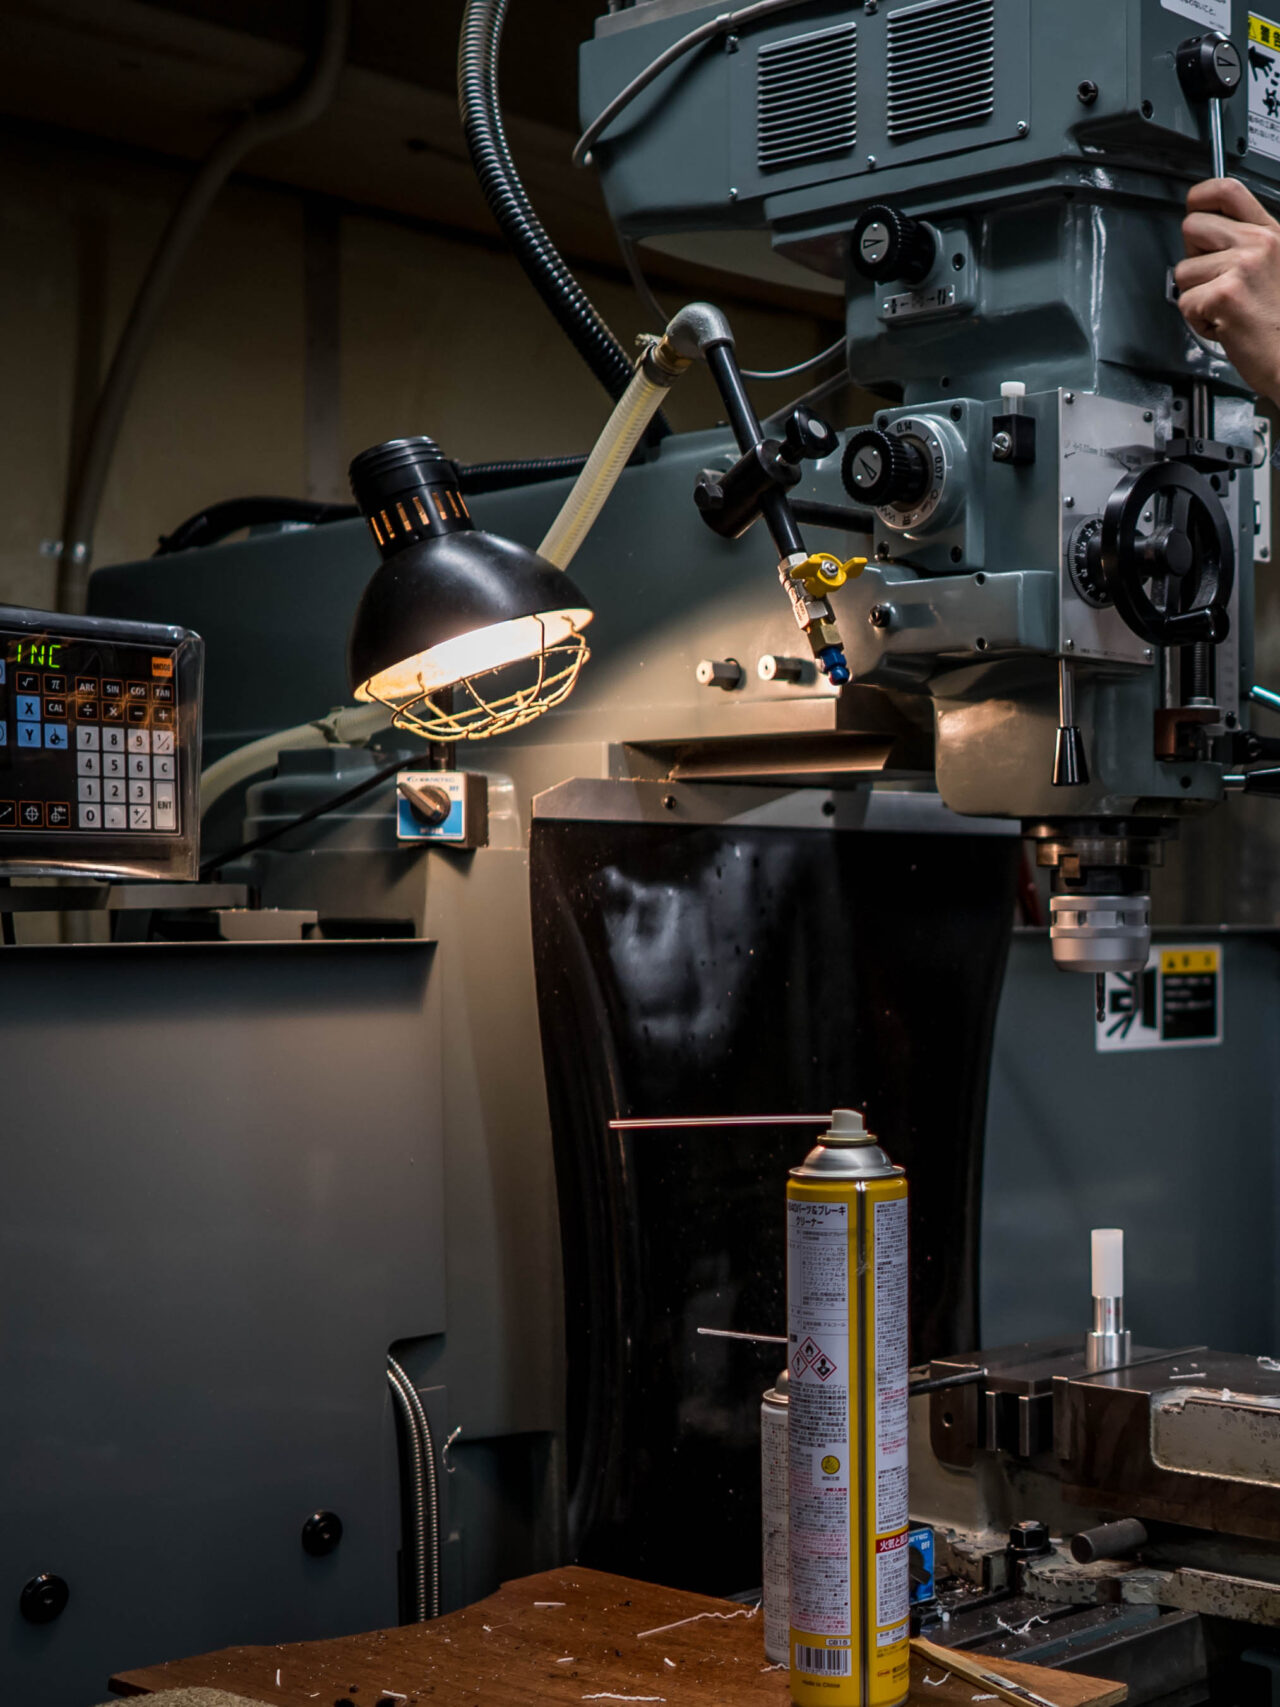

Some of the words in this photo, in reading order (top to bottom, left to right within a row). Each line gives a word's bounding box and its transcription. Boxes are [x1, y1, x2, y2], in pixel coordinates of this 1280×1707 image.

[935, 457, 943, 481] 0.07
[16, 644, 61, 669] INC
[79, 682, 95, 692] ARC
[106, 684, 120, 694] SIN
[130, 686, 146, 696] COS
[155, 688, 171, 699] TAN
[25, 702, 33, 715] X
[48, 703, 63, 713] CAL
[26, 729, 33, 741] Y
[85, 733, 92, 744] 7
[111, 734, 118, 745] 8
[136, 735, 143, 747] 9
[85, 758, 92, 770] 4
[111, 759, 118, 771] 5
[136, 760, 143, 772] 6
[161, 762, 168, 773] C
[86, 784, 92, 796] 1
[111, 785, 119, 797] 2
[137, 786, 144, 797] 3
[157, 800, 172, 810] ENT
[87, 810, 94, 822] 0
[796, 1215, 824, 1227] クリーナー
